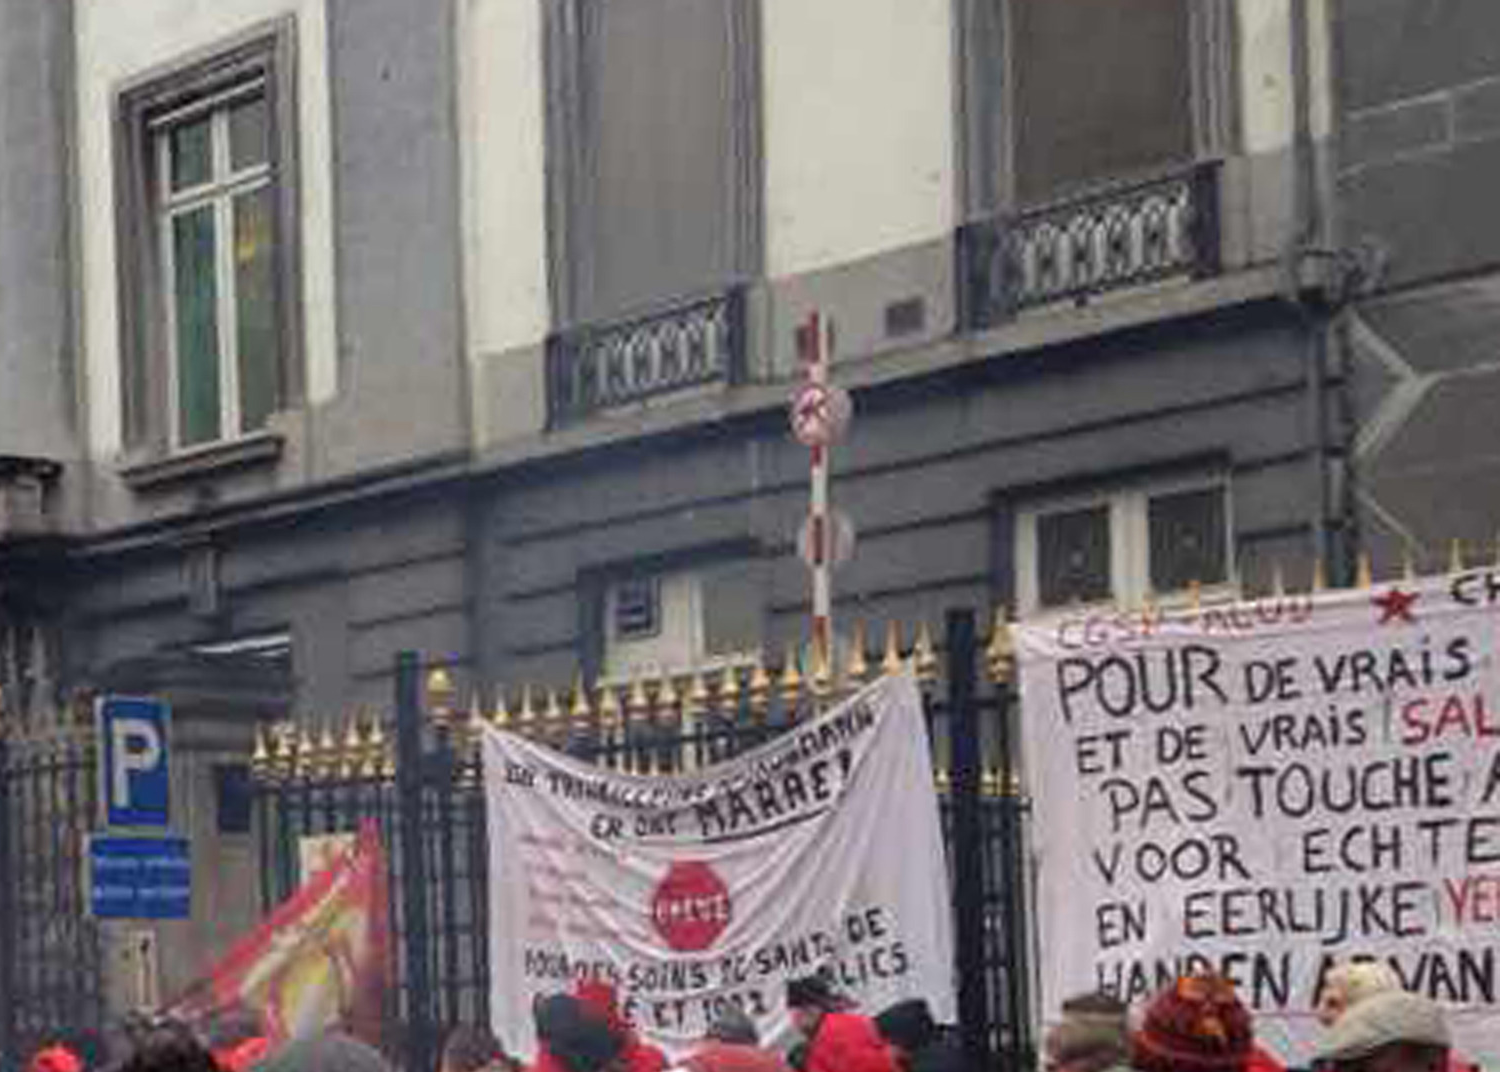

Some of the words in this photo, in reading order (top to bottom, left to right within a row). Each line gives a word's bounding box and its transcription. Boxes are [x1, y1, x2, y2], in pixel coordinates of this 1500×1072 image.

[1056, 645, 1229, 723] POUR
[1245, 659, 1301, 704] DE
[112, 718, 161, 807] P
[1077, 731, 1132, 774] ET
[1157, 724, 1208, 764] DE
[1100, 770, 1218, 832] PAS
[1237, 753, 1453, 820] TOUCHE
[1094, 834, 1251, 884] VOOR
[1303, 817, 1500, 873] ECHTE
[847, 908, 886, 944] DE
[1097, 902, 1147, 949] EN
[1183, 882, 1427, 946] EERLIJKE
[1388, 946, 1496, 1004] VAN
